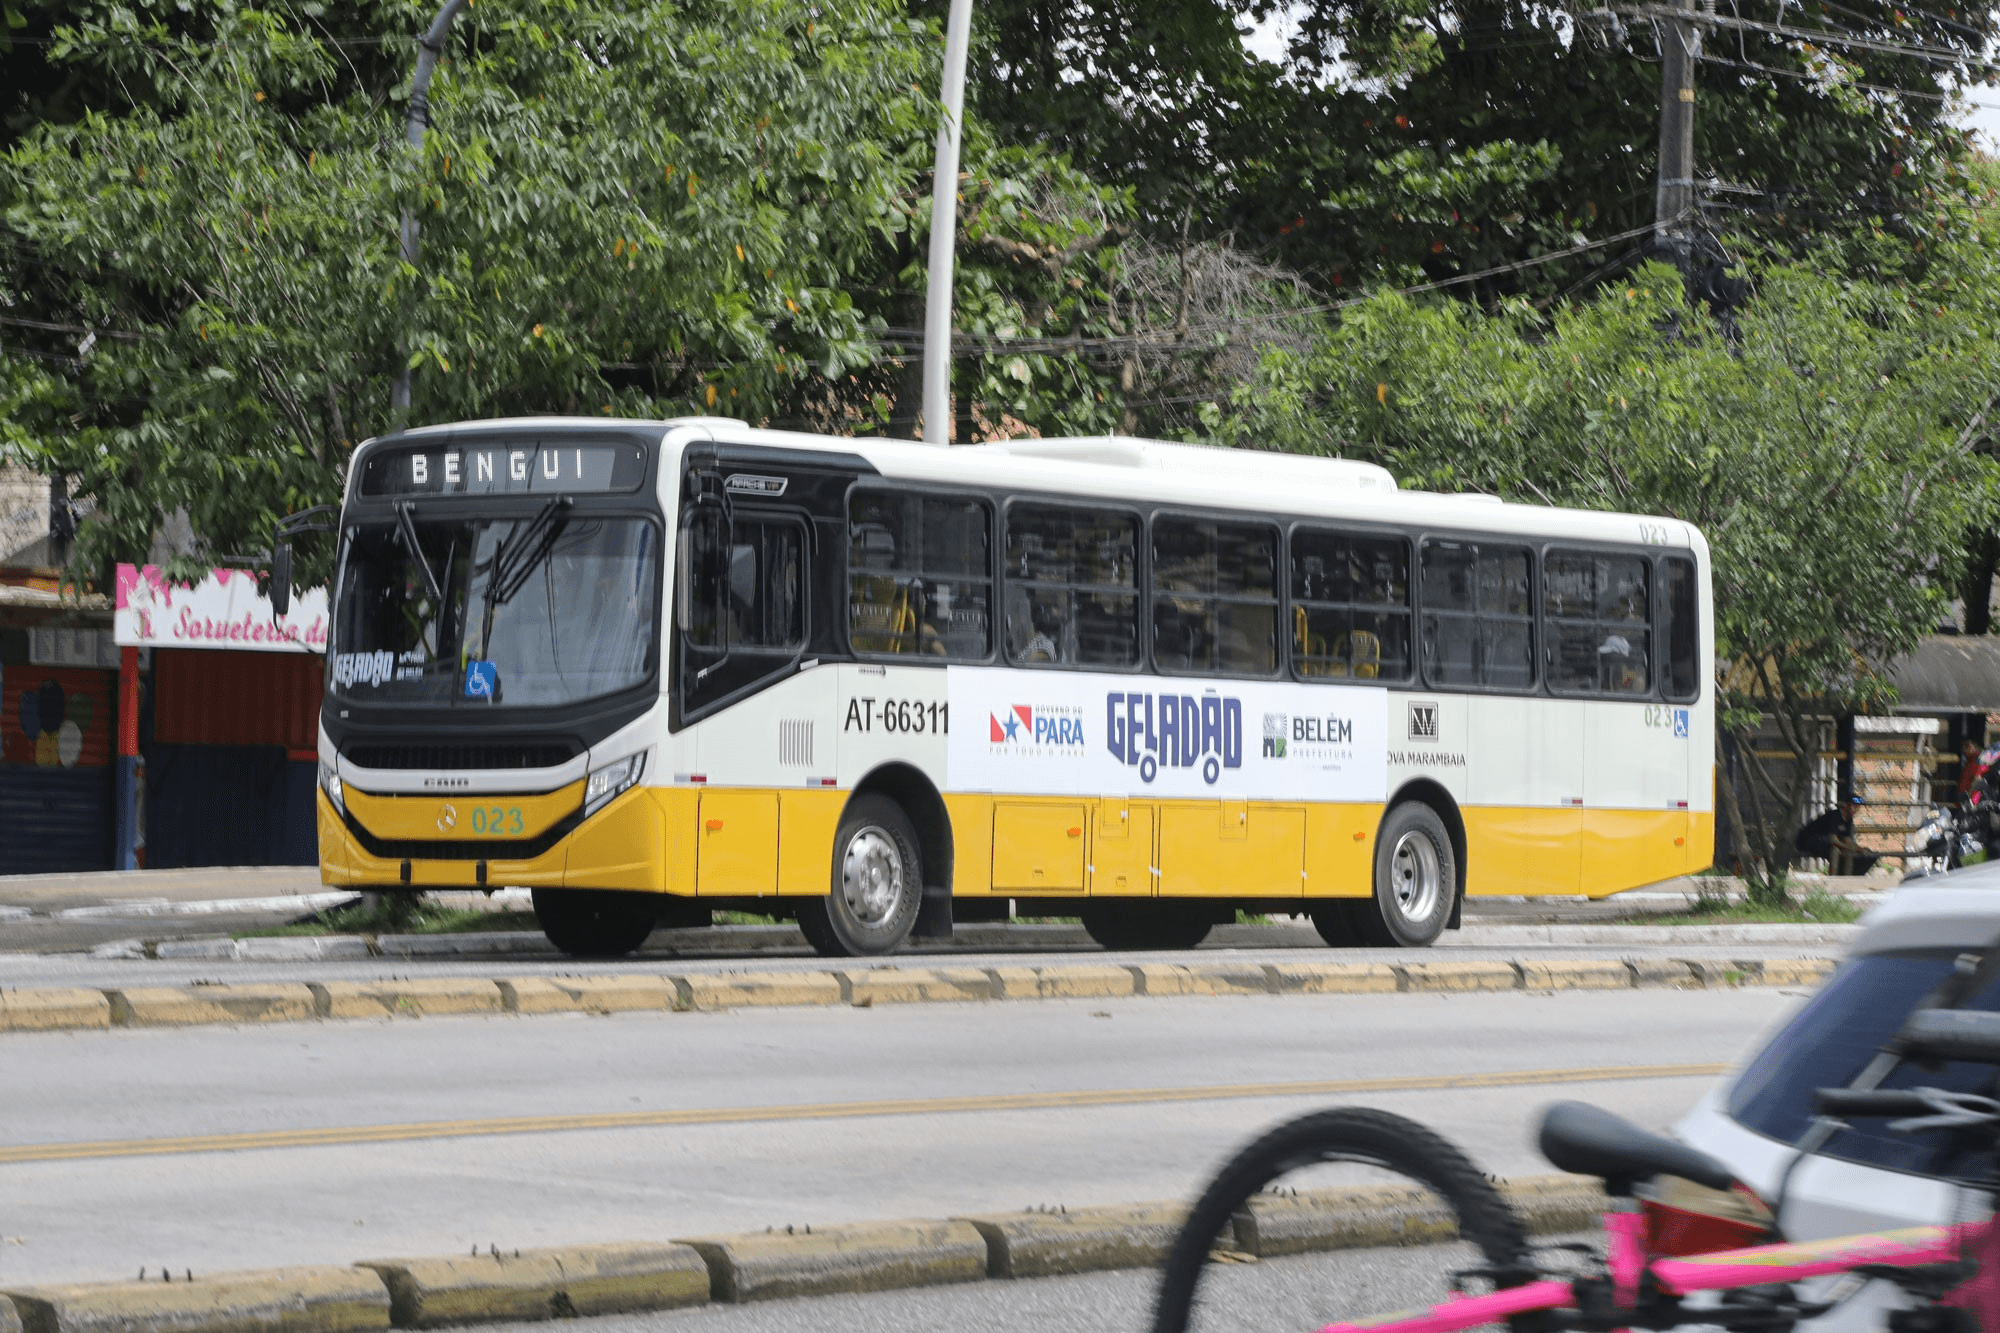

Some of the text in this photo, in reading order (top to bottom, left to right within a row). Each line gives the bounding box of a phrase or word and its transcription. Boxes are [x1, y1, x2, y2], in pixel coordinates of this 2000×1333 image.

[412, 449, 582, 484] BENGUI
[844, 697, 948, 735] AT-66311
[1644, 704, 1672, 727] 023
[1293, 747, 1353, 760] PREFEITURA
[1407, 751, 1466, 768] MARAMBAIA
[471, 806, 525, 836] 023
